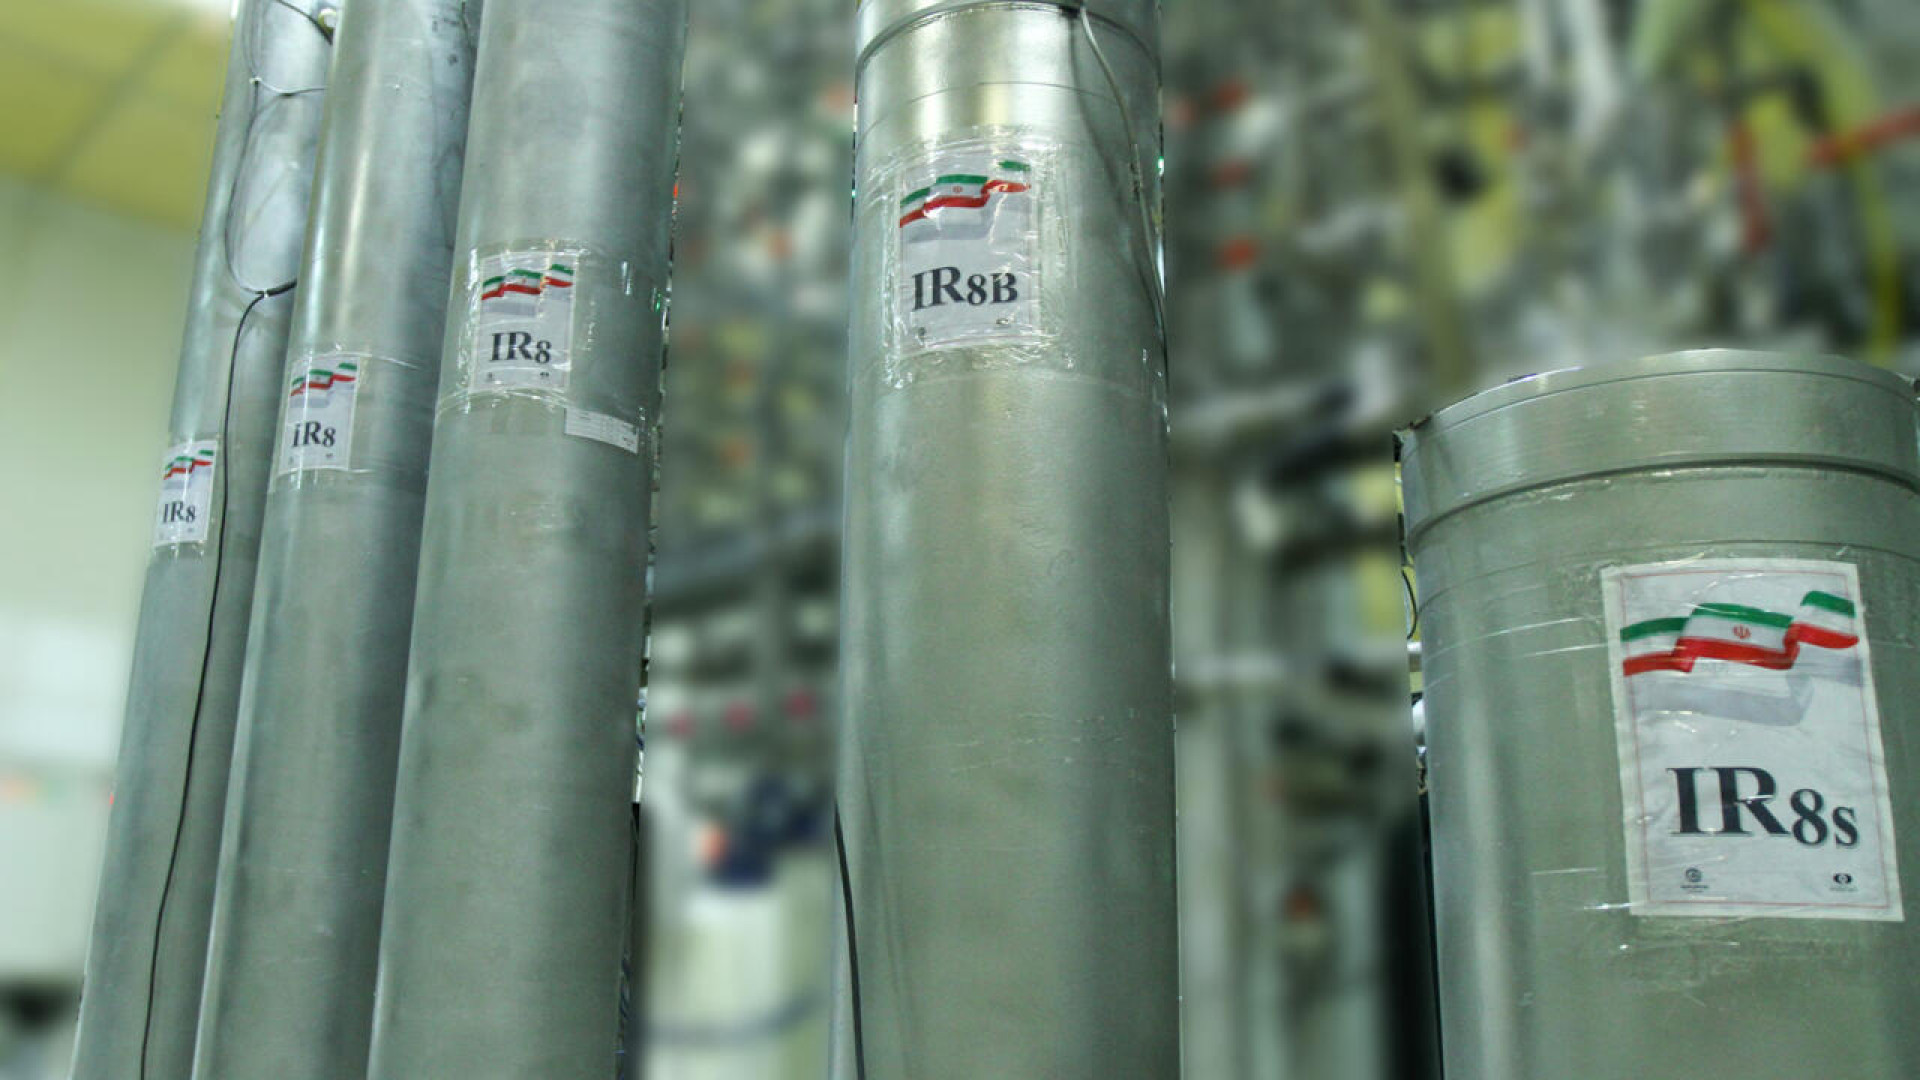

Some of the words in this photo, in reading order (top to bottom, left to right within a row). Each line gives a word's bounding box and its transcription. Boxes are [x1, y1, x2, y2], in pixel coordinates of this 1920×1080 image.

[912, 266, 1018, 312] IR8B
[490, 331, 552, 364] IR8
[163, 501, 196, 523] IR8
